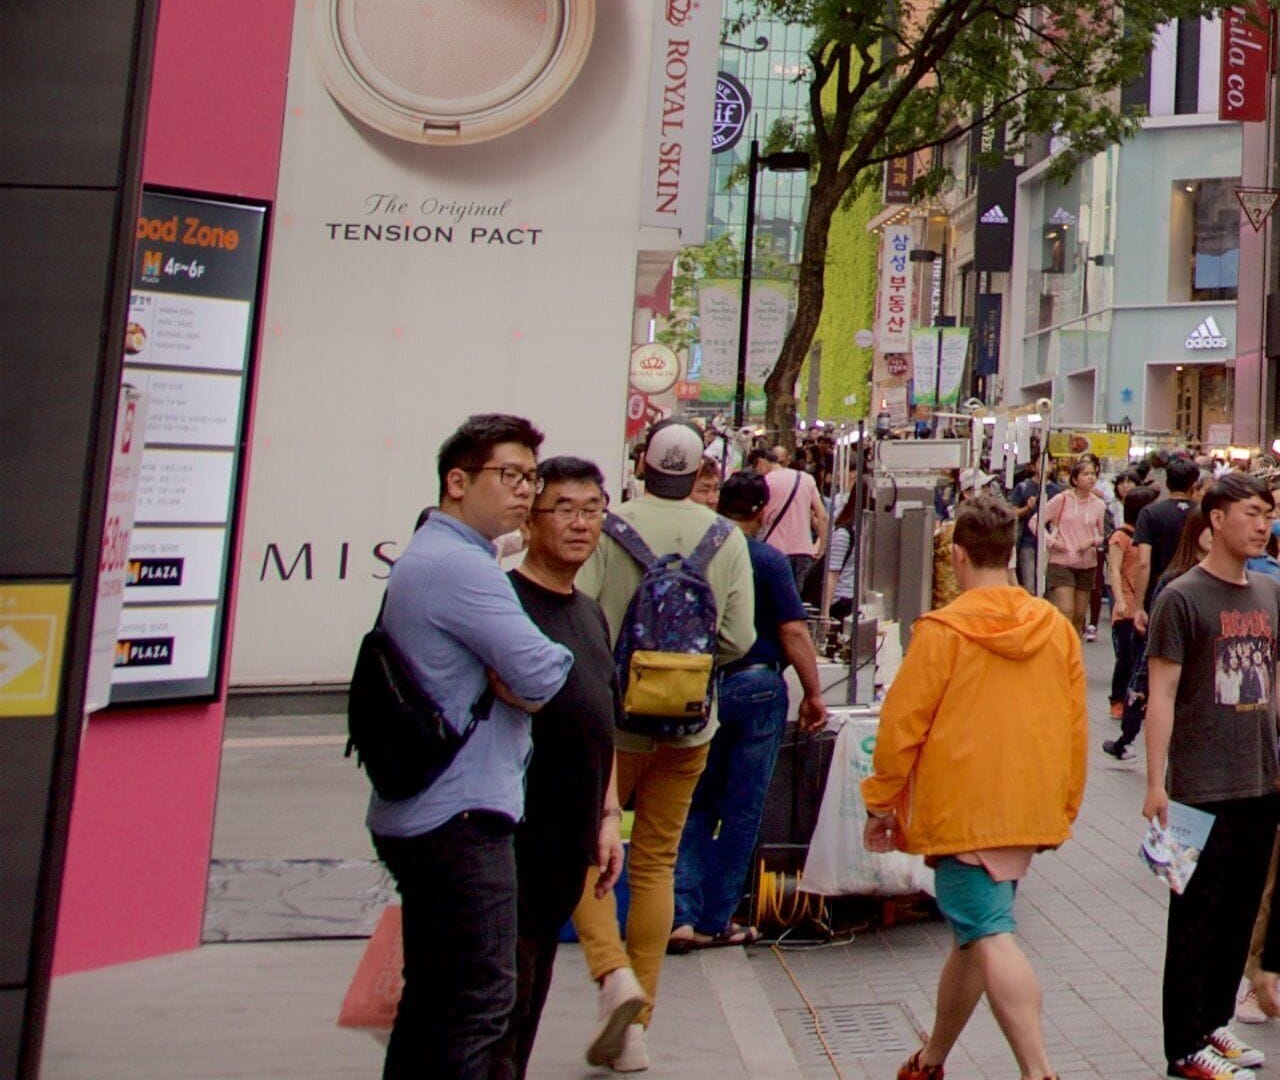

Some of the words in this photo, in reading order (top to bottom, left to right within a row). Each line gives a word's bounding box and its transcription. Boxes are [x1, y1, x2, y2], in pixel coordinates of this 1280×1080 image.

[660, 38, 691, 136] ROYAL
[1227, 73, 1246, 112] co.
[655, 142, 683, 215] SKIN
[364, 193, 409, 215] The
[421, 198, 512, 224] Original
[137, 215, 178, 243] ood
[182, 217, 240, 250] Zone
[325, 223, 453, 243] TENSION
[471, 226, 543, 246] PACT
[1185, 336, 1228, 349] adidas
[141, 564, 178, 580] PLAZA
[260, 541, 398, 582] MIS
[130, 644, 169, 660] PLAZA
